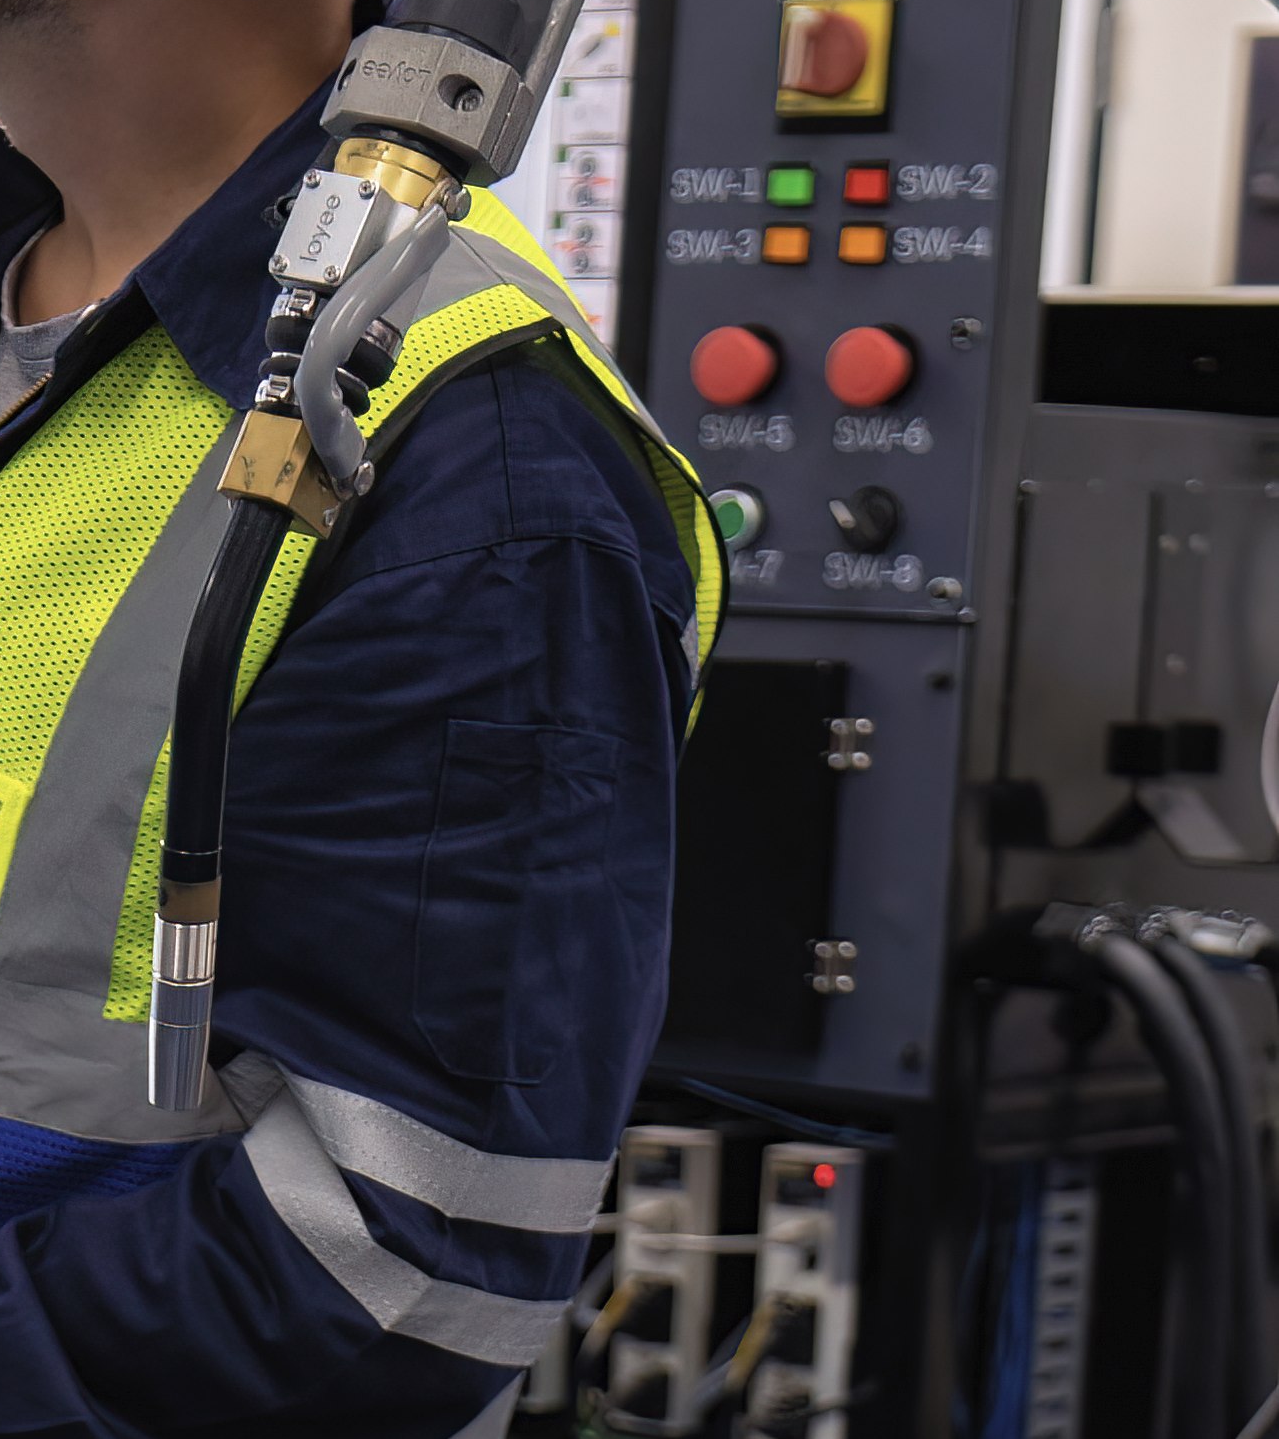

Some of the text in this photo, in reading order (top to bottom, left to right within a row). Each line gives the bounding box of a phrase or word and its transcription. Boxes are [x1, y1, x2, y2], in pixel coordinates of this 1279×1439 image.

[670, 167, 761, 203] SW-1
[896, 164, 998, 201] SW-2
[299, 194, 341, 262] loyee
[892, 226, 995, 262] SW-4
[697, 414, 796, 453] SW-5
[833, 415, 934, 454] SW-6
